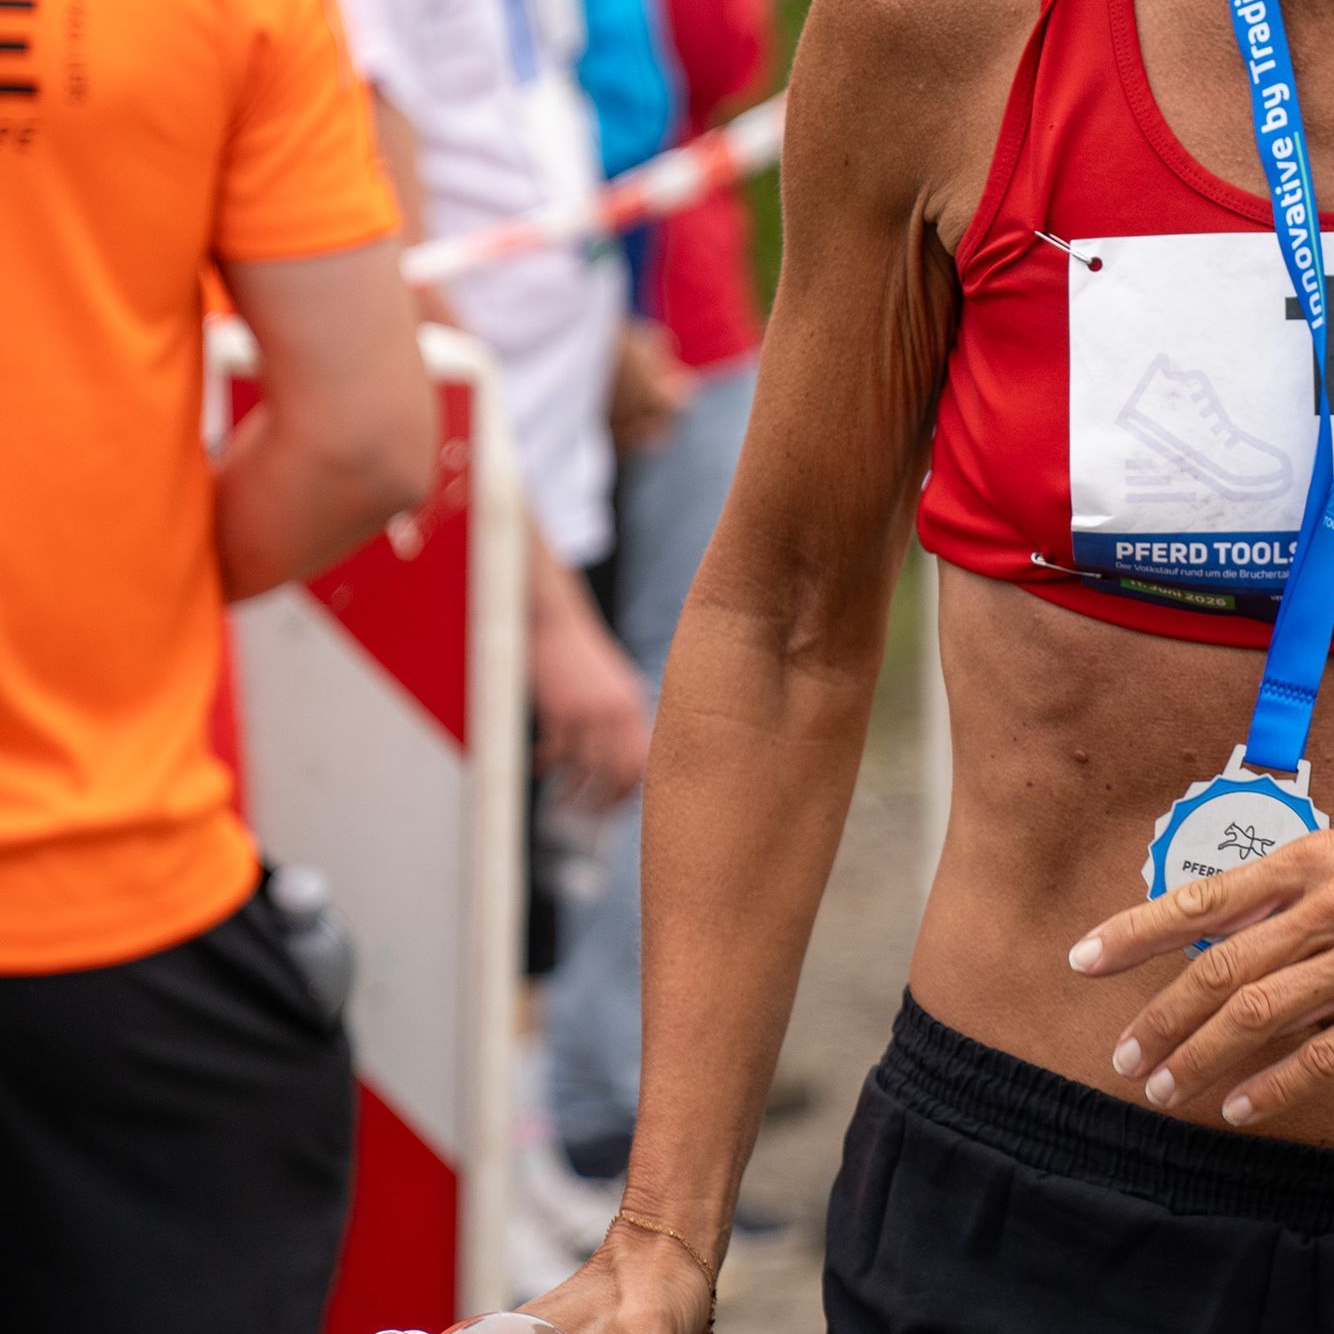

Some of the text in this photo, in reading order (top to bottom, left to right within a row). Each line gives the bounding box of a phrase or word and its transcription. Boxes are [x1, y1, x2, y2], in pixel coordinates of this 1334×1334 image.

[1260, 82, 1290, 134] by
[1270, 136, 1325, 330] Innovative
[1115, 541, 1209, 565] PFERD
[1115, 561, 1132, 571] Der
[1134, 563, 1179, 576] Volkslauf
[1180, 568, 1204, 578] rund
[1205, 570, 1220, 578] um
[1222, 568, 1237, 578] die
[1184, 592, 1227, 608] 2026
